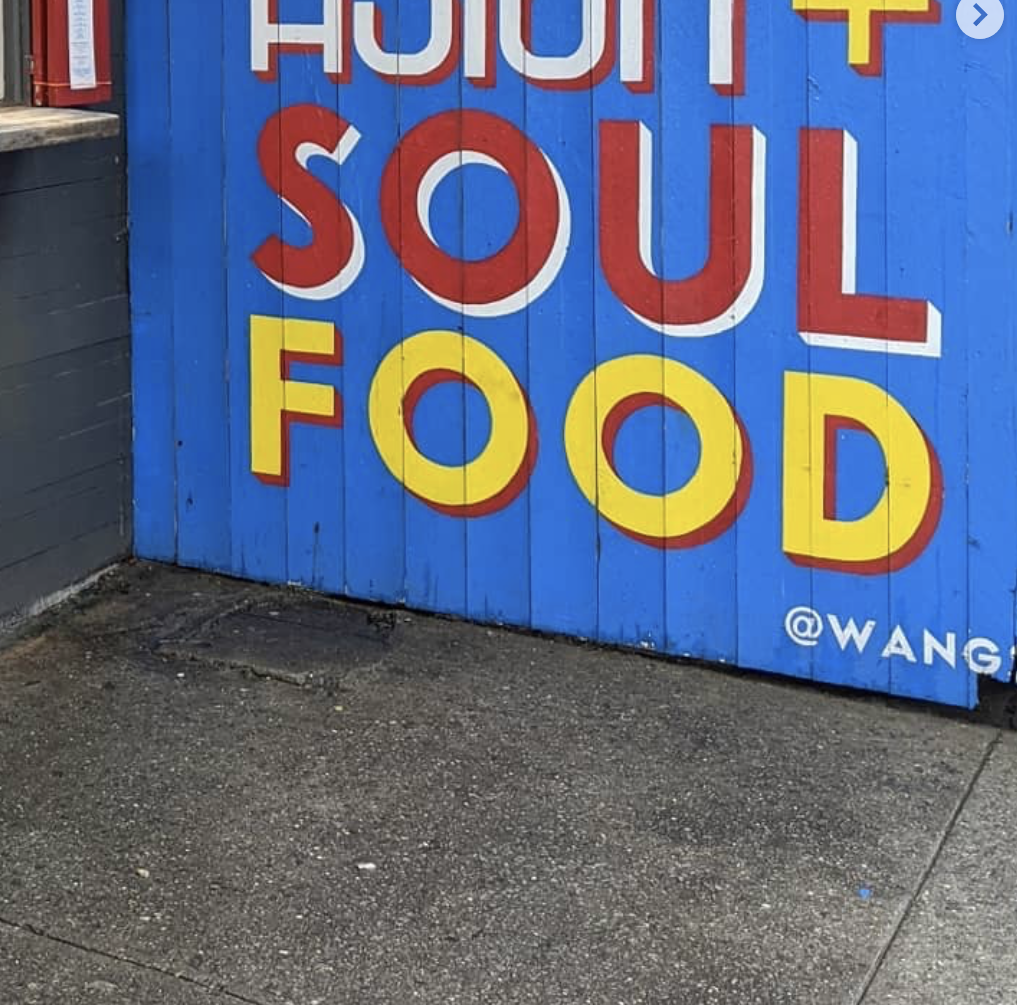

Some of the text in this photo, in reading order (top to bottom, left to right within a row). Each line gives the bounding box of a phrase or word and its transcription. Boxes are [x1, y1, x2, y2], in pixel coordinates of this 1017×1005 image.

[251, 102, 943, 358] SOUL
[249, 315, 944, 576] FOOD
[785, 606, 1017, 677] @WANG
